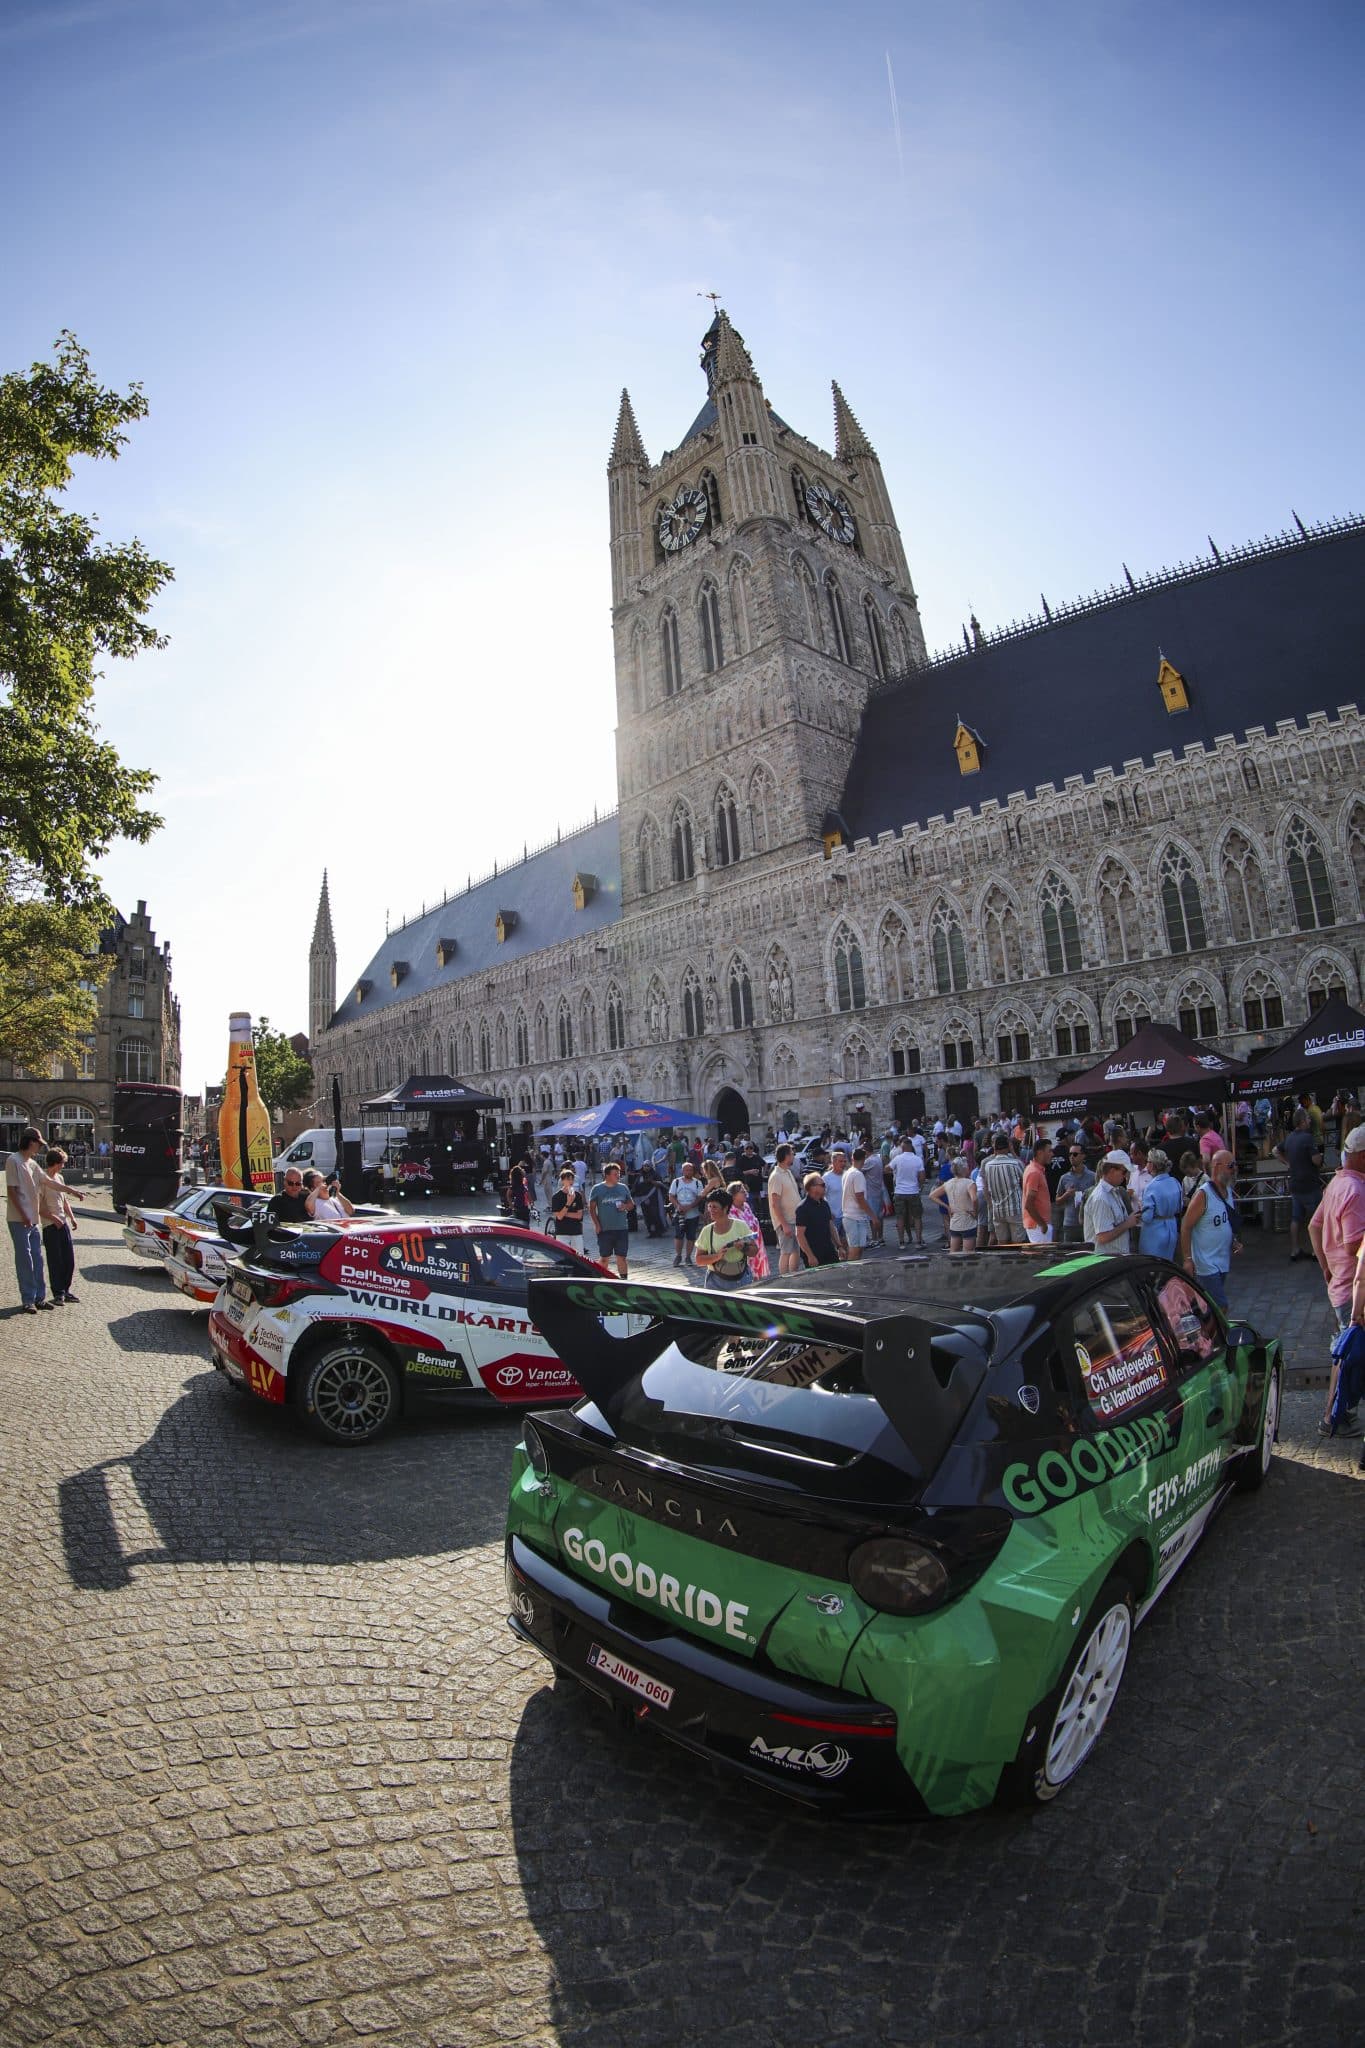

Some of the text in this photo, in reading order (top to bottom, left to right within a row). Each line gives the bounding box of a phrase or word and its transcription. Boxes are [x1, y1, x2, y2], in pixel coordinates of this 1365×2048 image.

[1304, 1029, 1365, 1049] MY CLUB
[1106, 1059, 1166, 1074] MY CLUB
[1252, 1077, 1294, 1088] ardeca
[1050, 1098, 1088, 1109] ardeca
[251, 1212, 276, 1225] FPC
[344, 1246, 369, 1259] FPC
[398, 1232, 426, 1263] 10
[386, 1259, 459, 1279] A. Vanrobaeys
[427, 1256, 458, 1270] B. Syx
[341, 1265, 411, 1288] Del'haye
[406, 1360, 463, 1380] DEGROOTE
[417, 1352, 457, 1368] Bernard
[528, 1368, 576, 1383] Vancay
[1090, 1352, 1155, 1393] Ch. Merlevede
[1100, 1372, 1160, 1414] G. Vandromme
[1002, 1410, 1175, 1513] GOODRIDE
[592, 1468, 738, 1537] LANCIA
[563, 1527, 749, 1641] GOODRIDE
[597, 1655, 670, 1703] 2-JNM-060
[749, 1749, 774, 1763] wheels
[782, 1761, 802, 1771] tyres
